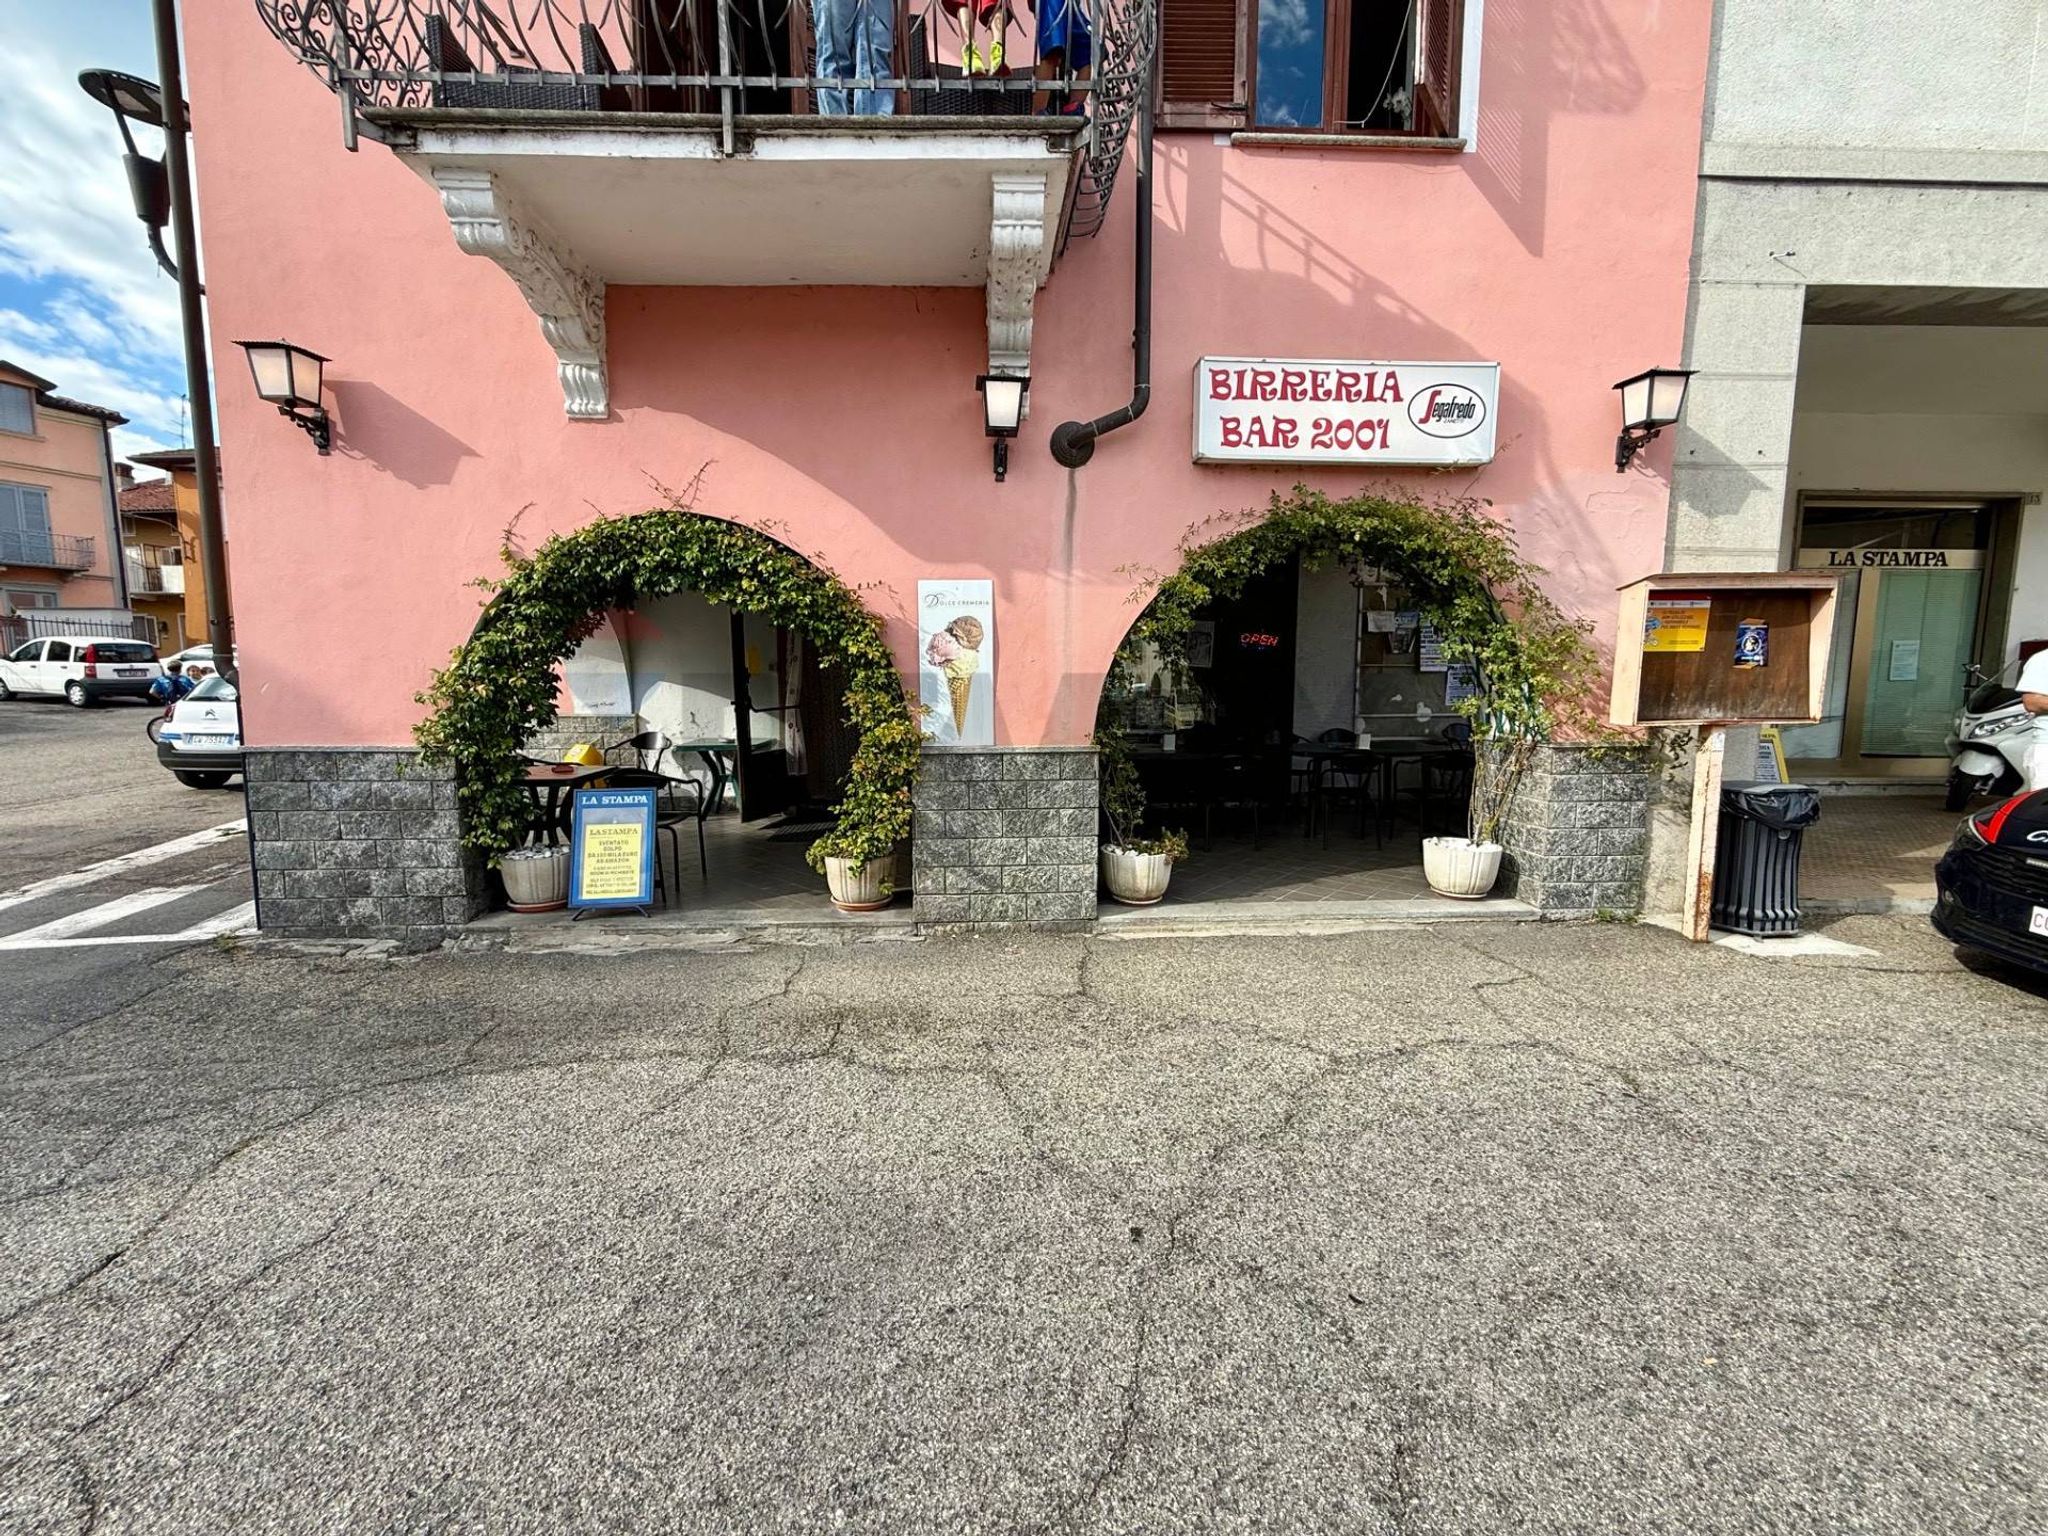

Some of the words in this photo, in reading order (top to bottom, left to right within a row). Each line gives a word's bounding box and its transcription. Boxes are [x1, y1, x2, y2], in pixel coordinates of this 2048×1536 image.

[1209, 368, 1403, 403] BIRRERIA
[1418, 390, 1476, 424] Segafredo
[1220, 416, 1299, 448] BAR
[1311, 417, 1390, 450] 2001
[1828, 550, 1857, 567] LA
[1862, 550, 1949, 568] STAMPA
[1240, 633, 1279, 647] OPEN
[582, 796, 598, 805] LA
[602, 795, 648, 805] STAMPA
[602, 828, 638, 836] STAMPA
